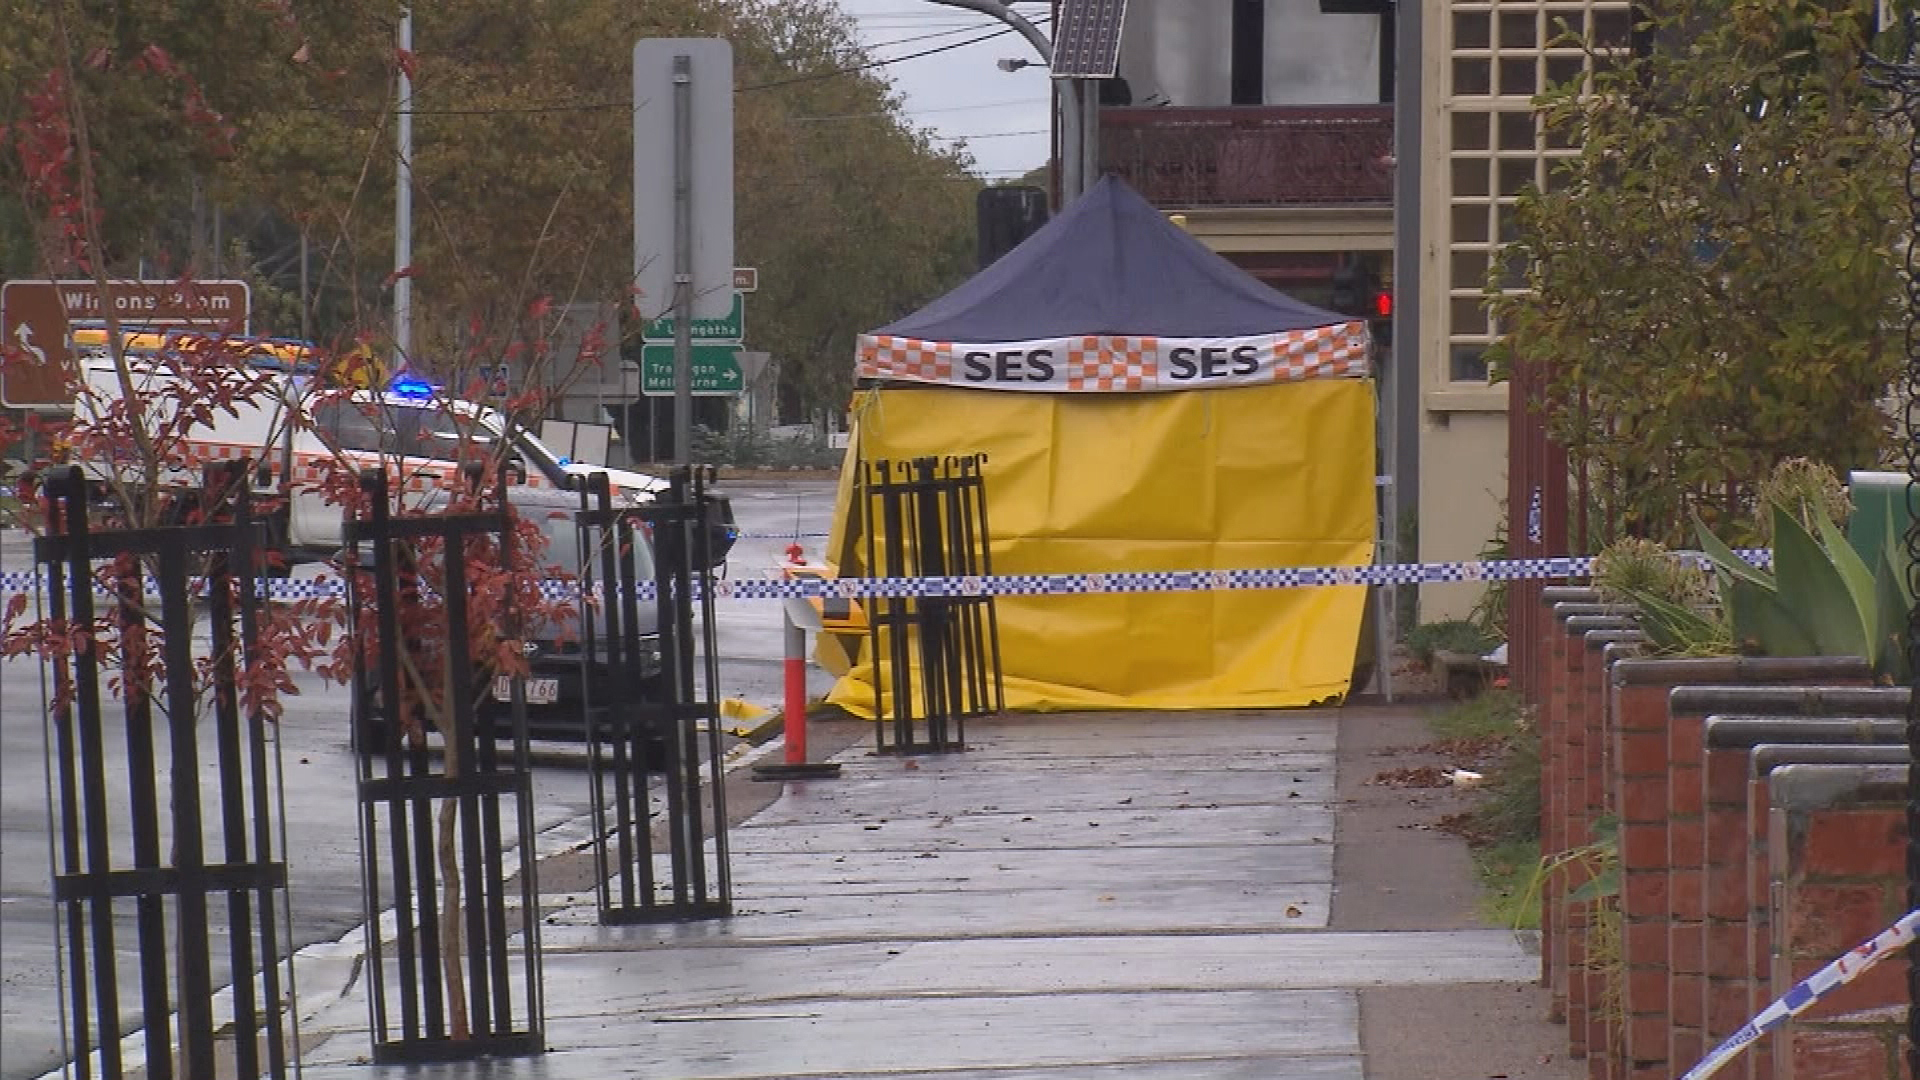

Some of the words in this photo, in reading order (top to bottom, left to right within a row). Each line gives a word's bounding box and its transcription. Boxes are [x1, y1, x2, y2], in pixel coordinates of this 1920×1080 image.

[667, 324, 737, 337] Lngatha
[651, 363, 717, 376] Tragon
[964, 349, 1054, 382] SES
[1168, 346, 1258, 380] SES
[648, 377, 718, 387] Melrne
